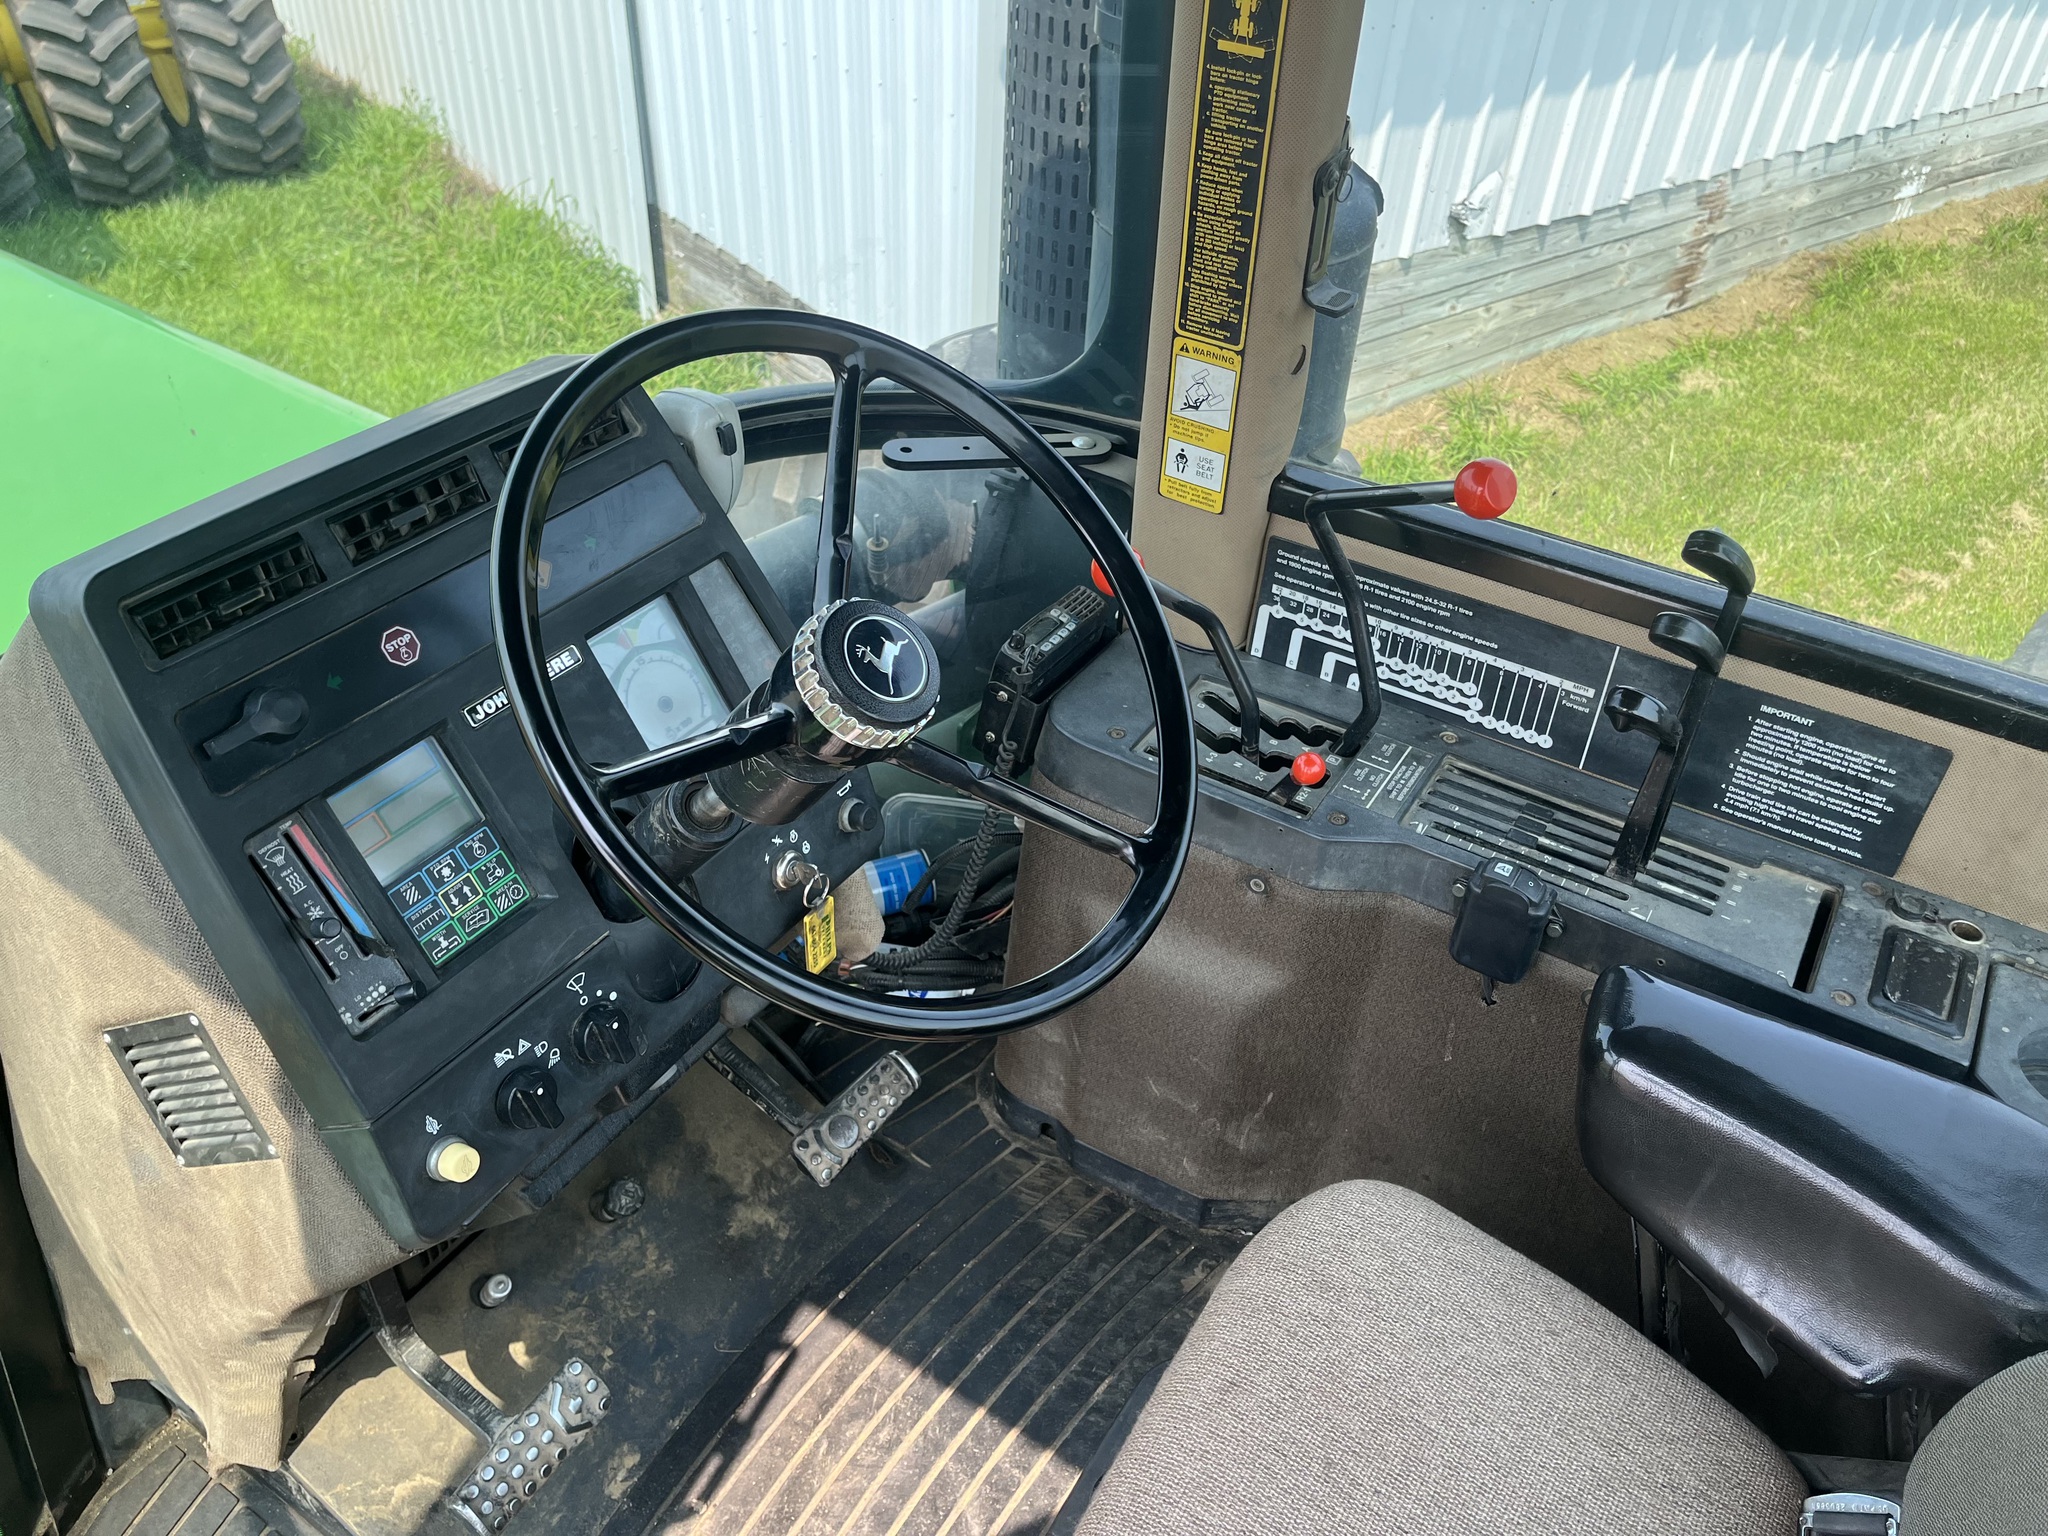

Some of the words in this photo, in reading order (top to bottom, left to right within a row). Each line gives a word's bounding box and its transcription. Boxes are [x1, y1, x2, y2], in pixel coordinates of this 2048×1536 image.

[1192, 346, 1235, 365] WARNING
[1196, 462, 1215, 473] SEAT
[1198, 456, 1214, 466] USE
[1195, 469, 1214, 480] BELT
[1277, 549, 1300, 561] Ground
[1299, 557, 1322, 568] speeds
[1354, 574, 1390, 590] pproximate
[1390, 586, 1410, 596] values
[1410, 593, 1424, 601] with
[1424, 596, 1447, 608] 24.5-32
[1447, 603, 1458, 611] R-1
[1458, 607, 1473, 616] tires
[1288, 561, 1302, 569] 1900
[1301, 566, 1322, 576] engine
[1322, 572, 1335, 580] rpm
[1363, 584, 1374, 593] R-1
[1374, 588, 1388, 597] tires
[1401, 597, 1416, 606] 2100
[1415, 602, 1437, 613] engine
[1437, 609, 1451, 617] rpm
[1274, 571, 1286, 580] See
[1286, 576, 1315, 590] operator's
[1315, 586, 1338, 597] manual
[1369, 603, 1383, 611] with
[1382, 608, 1400, 617] other
[1399, 613, 1410, 621] tire
[1410, 617, 1427, 626] sizes
[1434, 625, 1452, 634] other
[1452, 630, 1474, 641] engine
[1474, 637, 1498, 649] speeds
[385, 633, 411, 652] STOP
[1289, 600, 1297, 608] 32
[1569, 693, 1587, 704] km/h
[1572, 684, 1589, 693] MPH
[475, 689, 508, 720] JOH
[1561, 699, 1590, 714] Forward
[1760, 704, 1815, 727] IMPORTANT
[1752, 725, 1801, 745] approximately
[1801, 740, 1817, 749] 1200
[1816, 745, 1832, 754] rpm
[1831, 749, 1844, 758] (no
[1844, 753, 1863, 765] load)
[1863, 759, 1874, 767] for
[1873, 764, 1888, 772] one
[1754, 718, 1773, 727] After
[1772, 724, 1800, 737] starting
[1799, 733, 1825, 746] engine,
[1825, 741, 1853, 754] operate
[1853, 750, 1878, 762] engine
[1745, 743, 1773, 755] minutes
[1773, 751, 1785, 759] (no
[1785, 755, 1804, 766] load).
[1750, 730, 1764, 738] two
[1763, 735, 1792, 748] minutes.
[1799, 746, 1842, 764] temperature
[1849, 762, 1871, 773] below
[1748, 736, 1775, 750] freezing
[1774, 746, 1794, 756] point,
[1795, 752, 1823, 765] operate
[1822, 761, 1847, 773] engine
[1846, 768, 1858, 776] for
[1857, 772, 1871, 781] two
[1880, 779, 1896, 788] four
[1205, 752, 1218, 763] 4-3
[1255, 771, 1267, 782] 2-1
[1295, 787, 1312, 802] R2-1
[279, 820, 293, 831] TEMP
[1720, 805, 1734, 814] See
[1733, 811, 1767, 826] operator's
[1766, 822, 1792, 834] manual
[1791, 830, 1814, 842] before
[1813, 838, 1837, 851] towing
[1837, 846, 1862, 859] vehicle.
[257, 838, 281, 855] DEFROST
[280, 866, 294, 878] HEAT
[429, 862, 440, 872] PTO
[440, 855, 451, 865] RPM
[400, 881, 413, 893] AREA
[447, 881, 464, 895] ADJUST
[496, 881, 513, 895] AREA/H
[411, 904, 433, 921] DISTANCE
[462, 905, 480, 920] SERVICE
[431, 929, 447, 942] WIDTH
[334, 943, 344, 953] OFF
